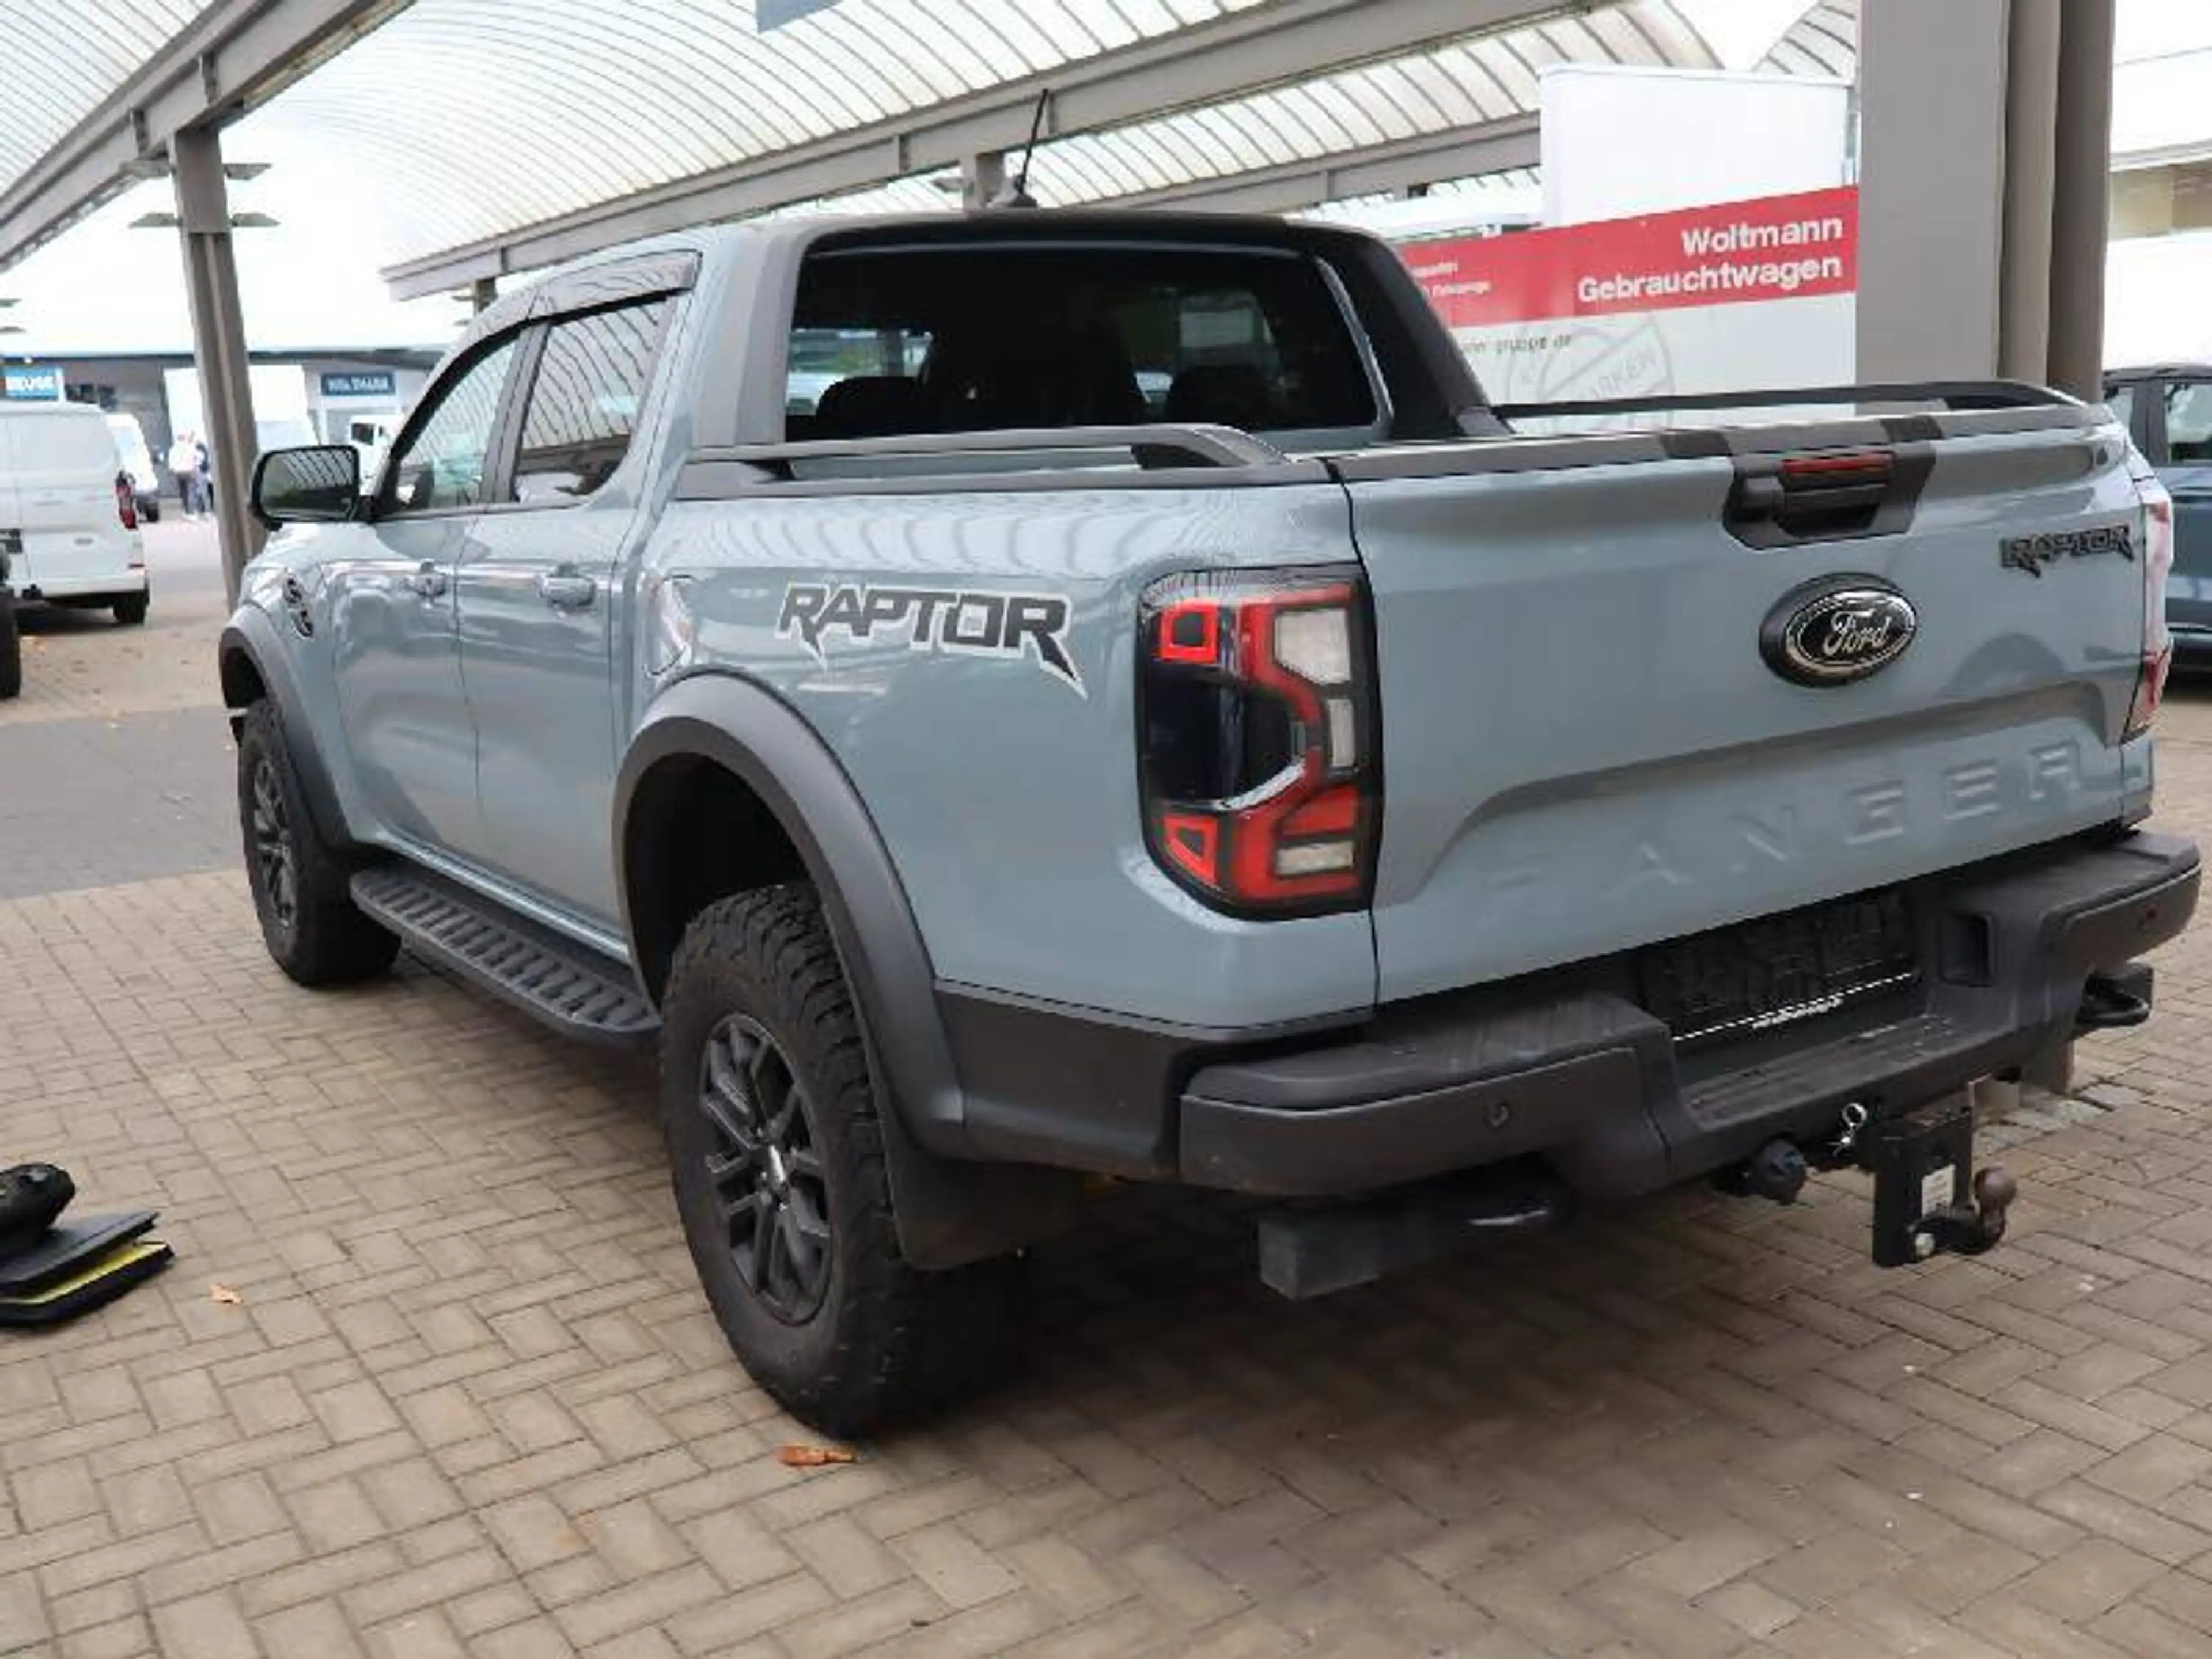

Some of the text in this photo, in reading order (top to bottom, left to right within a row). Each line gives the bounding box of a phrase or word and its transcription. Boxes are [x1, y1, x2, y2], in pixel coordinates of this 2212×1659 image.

[1681, 217, 1843, 255] Woltmann
[1578, 255, 1841, 302] Gebrauchtwagen
[2001, 523, 2135, 578] RAPTOR
[774, 582, 1089, 702] RAPTOR
[1822, 608, 1893, 656] Ford
